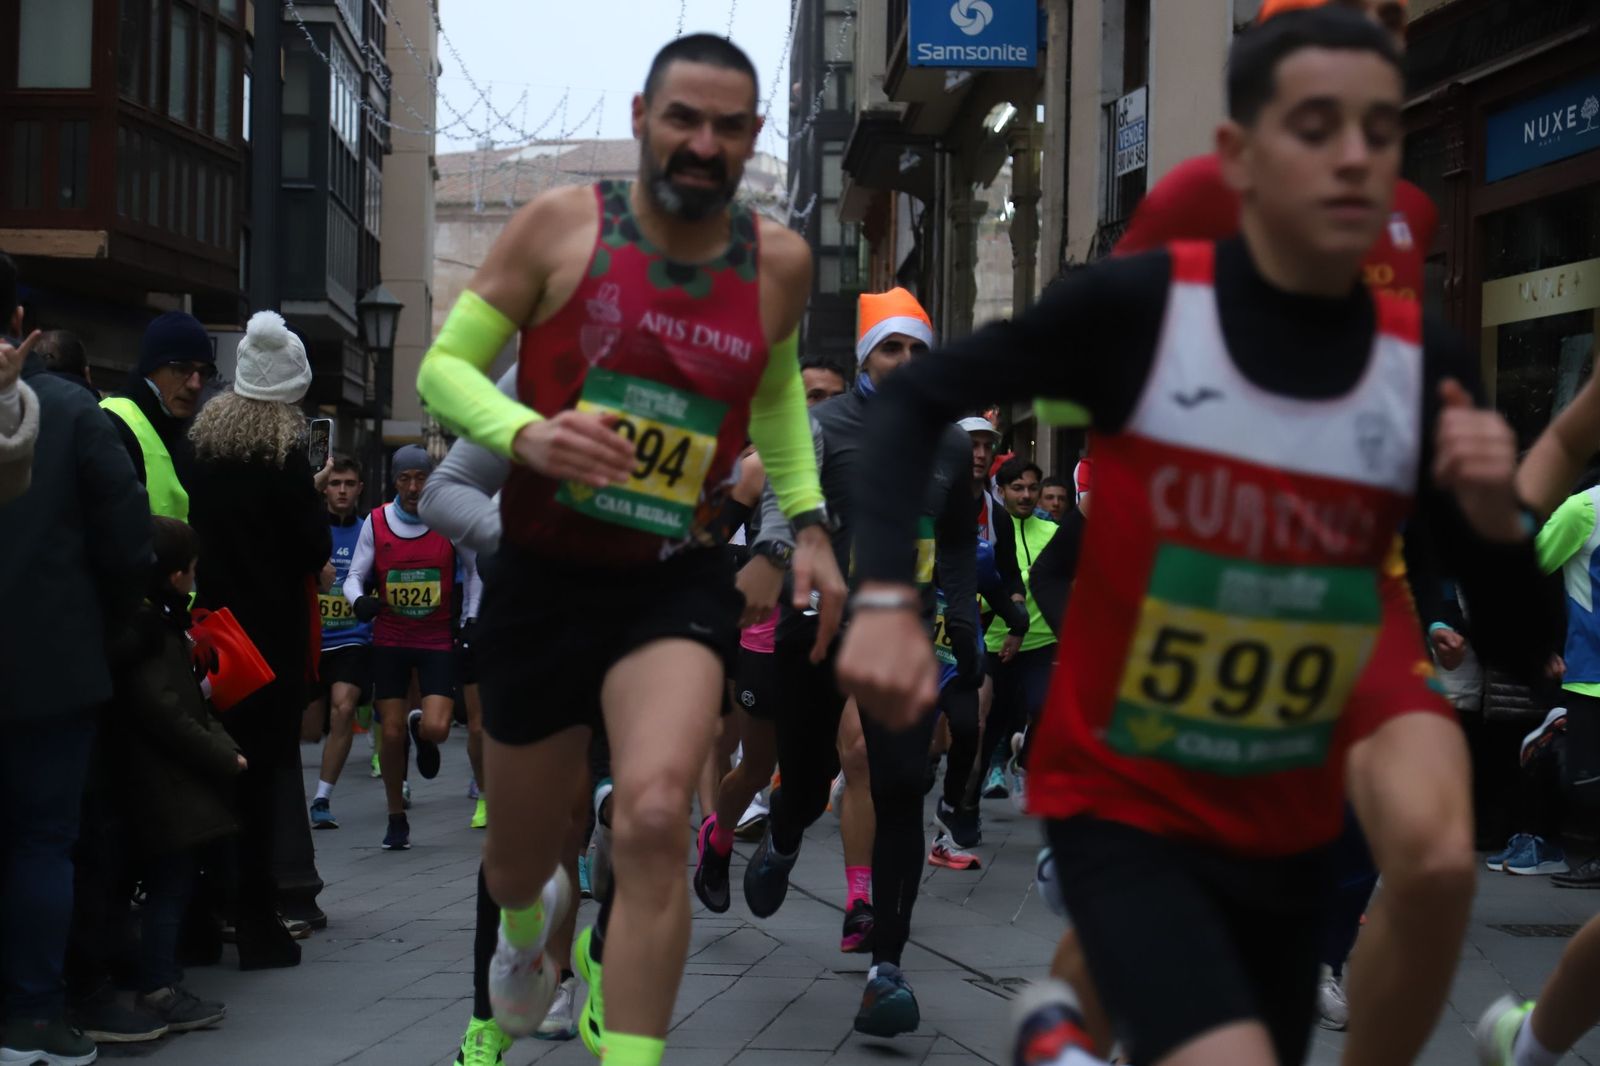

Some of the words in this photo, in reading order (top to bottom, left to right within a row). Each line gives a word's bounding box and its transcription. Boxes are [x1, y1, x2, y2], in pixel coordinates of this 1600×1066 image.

[917, 43, 1028, 61] Samsonite
[1119, 121, 1145, 150] VENDE
[1524, 105, 1577, 144] NUXE
[637, 310, 686, 342] APIS
[691, 323, 752, 362] DURI
[336, 547, 349, 557] 46
[389, 587, 432, 606] 1324
[1140, 623, 1336, 726] 599
